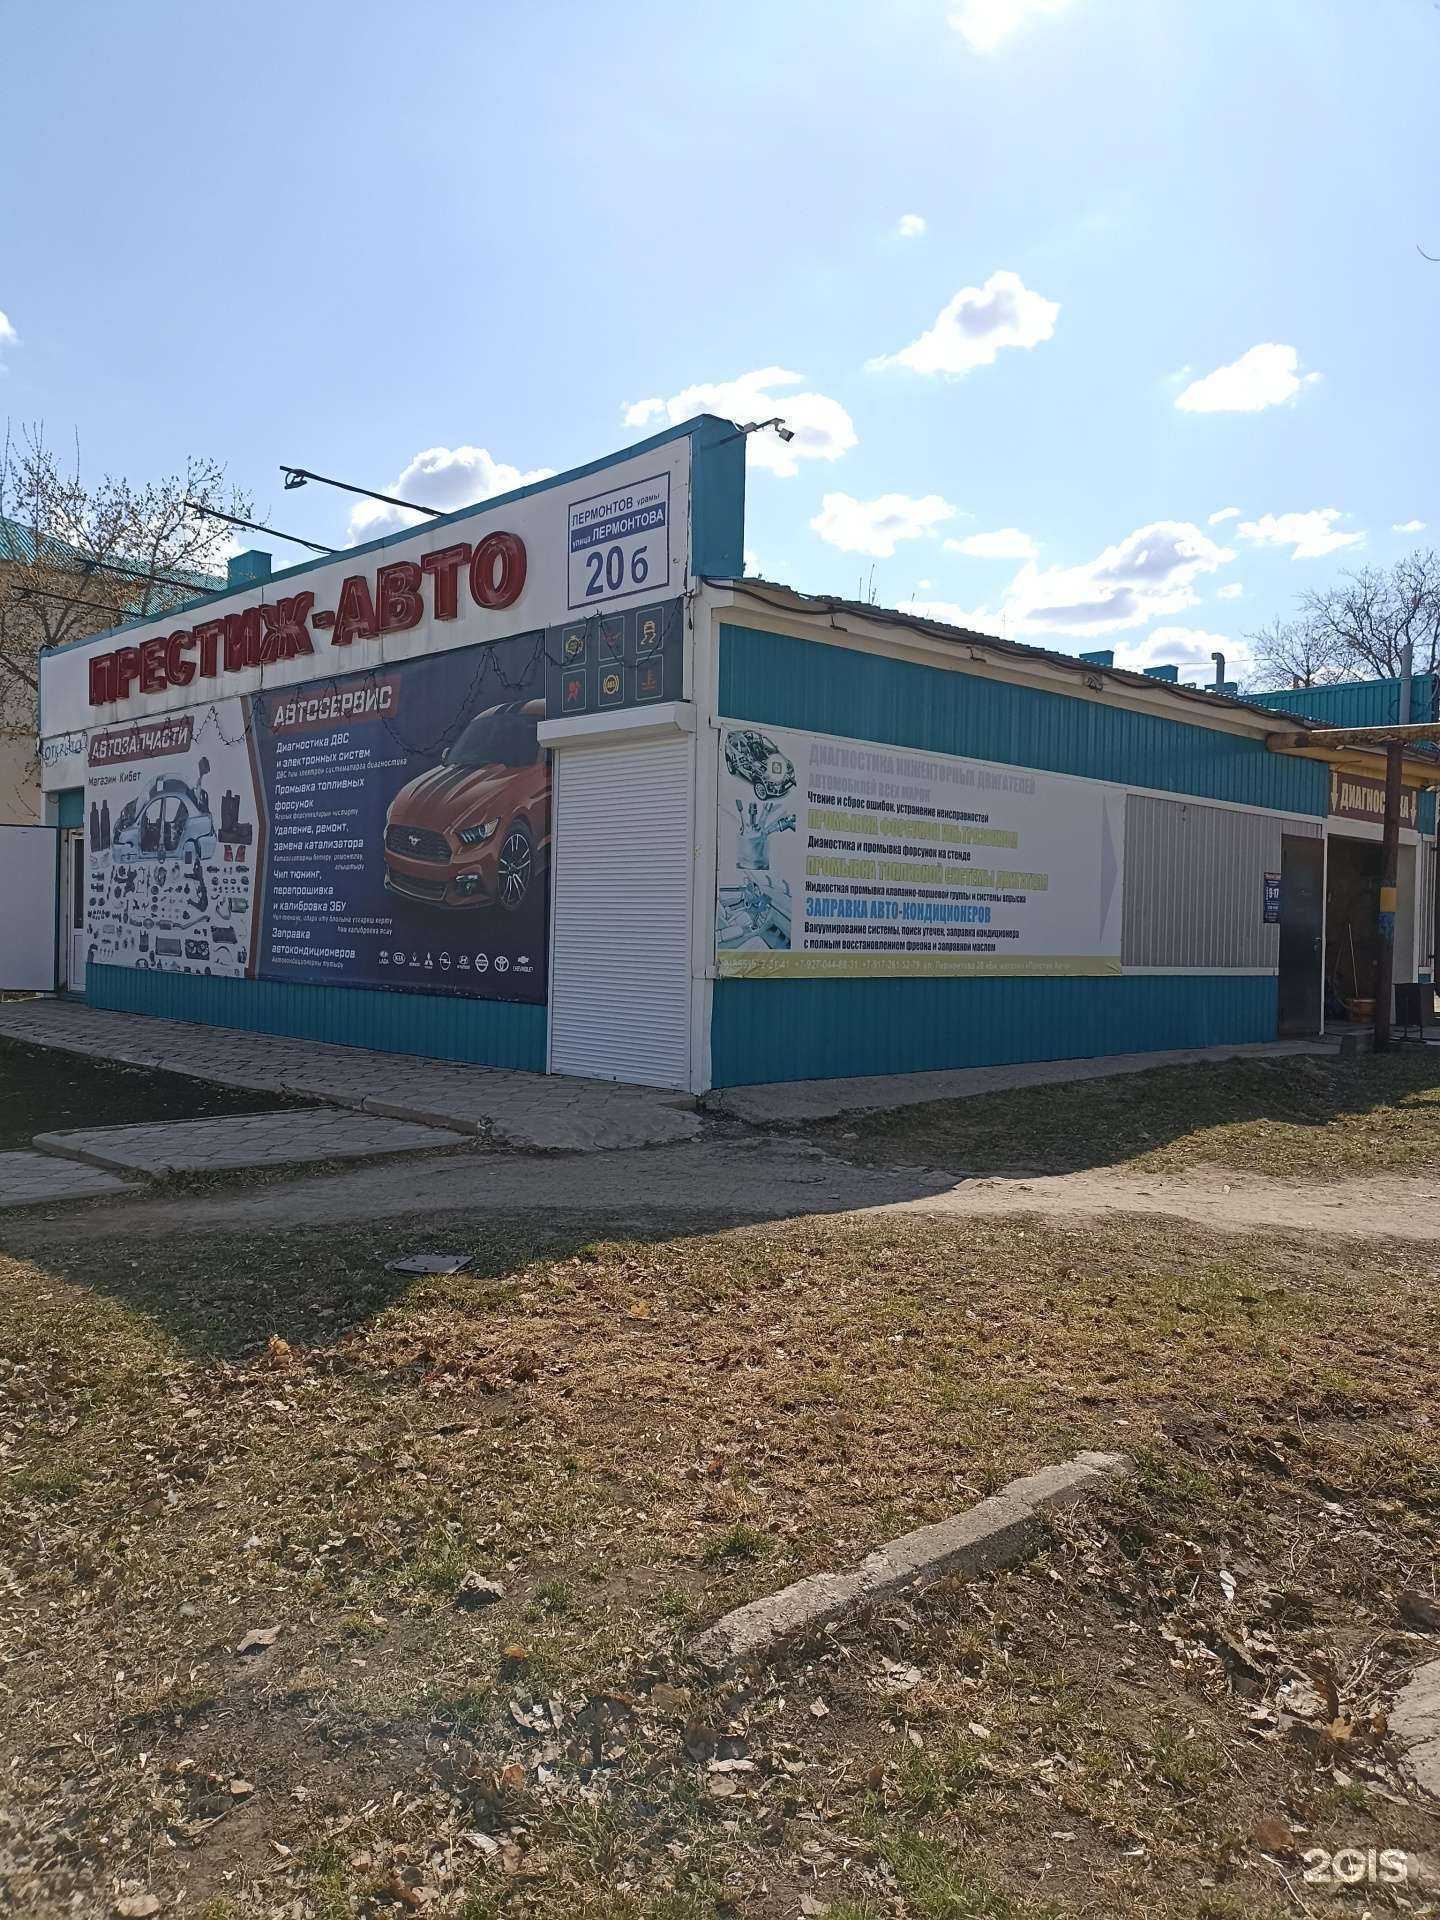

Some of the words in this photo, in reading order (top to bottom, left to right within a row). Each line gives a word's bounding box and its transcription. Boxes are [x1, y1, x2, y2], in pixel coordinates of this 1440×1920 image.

[571, 497, 633, 526] ЛЕРМОНТОВ
[637, 494, 660, 506] урамы
[572, 536, 591, 548] улица
[592, 509, 664, 541] ЛЕРМОНТОВА
[88, 531, 527, 705] ПРЕСТИЖ-АВТО
[274, 685, 392, 727] АВТОСЕРВИС
[91, 726, 188, 760] АВТОЗАПЧАСТИ
[276, 738, 329, 753] Диагностика
[331, 732, 350, 747] ДВС
[283, 752, 337, 768] электронных
[339, 749, 371, 761] систем
[275, 783, 316, 796] Промывка
[317, 778, 365, 791] топливных
[274, 799, 314, 812] форсунок
[808, 791, 836, 805] Чтение
[836, 797, 842, 806] и
[843, 796, 865, 809] сброс
[896, 803, 936, 816] устранение
[937, 809, 989, 823] неисправностей
[274, 824, 314, 836] Удаление,
[315, 823, 349, 835] ремонт,
[274, 841, 303, 851] замена
[304, 839, 364, 850] катализатора
[856, 842, 862, 851] и
[863, 842, 901, 855] промывка
[902, 845, 937, 858] форсунок
[938, 849, 946, 859] на
[947, 850, 971, 861] стенде
[273, 870, 288, 879] Чип
[290, 870, 322, 880] тюнинг,
[273, 886, 334, 896] перепрошивка
[805, 881, 849, 894] Жидкостная
[850, 885, 885, 896] промывка
[949, 891, 970, 901] группы
[976, 893, 1001, 902] системы
[279, 900, 328, 912] калибровка
[329, 901, 347, 912] ЭБУ
[806, 897, 868, 918] ЗАПРАВКА
[870, 900, 991, 924] АВТО-КОНДИЦИОНЕРОВ
[272, 927, 311, 939] Заправка
[804, 922, 866, 935] Вакуумирование
[867, 924, 900, 935] системы,
[901, 926, 922, 935] поиск
[922, 927, 946, 937] утечек,
[946, 928, 975, 938] заправка
[976, 929, 1020, 939] кондиционера
[272, 944, 356, 959] автокондиционеров
[810, 939, 841, 949] полным
[842, 939, 905, 950] восстановлением
[906, 941, 931, 951] фреона
[972, 943, 996, 952] маслом
